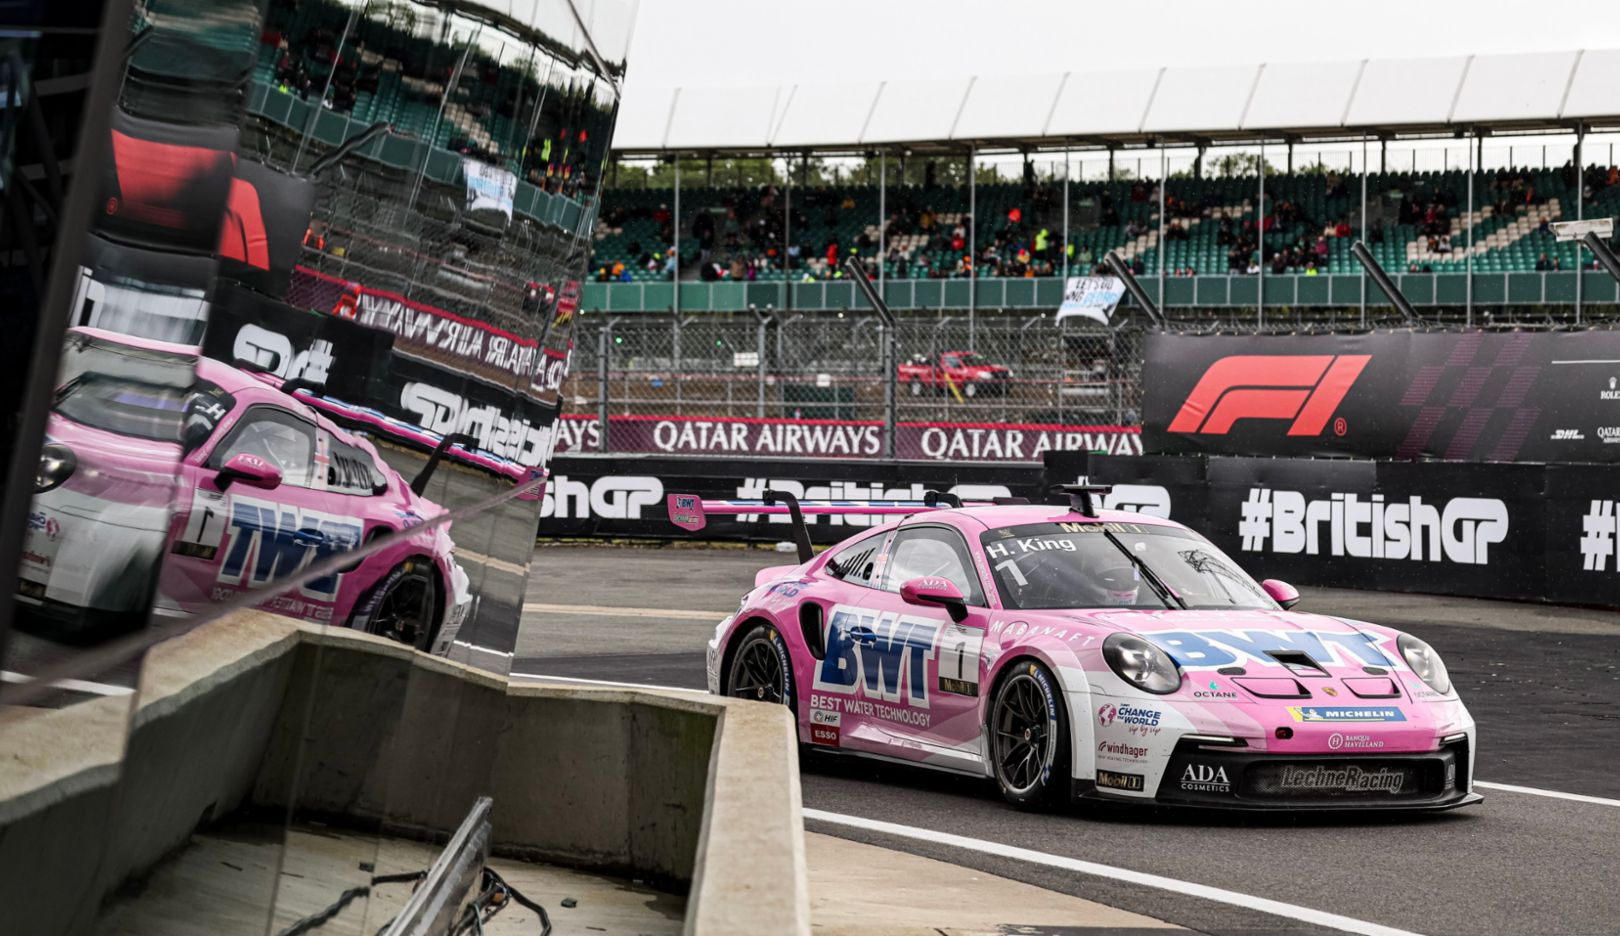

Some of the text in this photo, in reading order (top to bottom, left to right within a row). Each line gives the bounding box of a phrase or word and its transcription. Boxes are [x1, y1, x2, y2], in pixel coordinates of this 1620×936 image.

[653, 421, 881, 454] QATAR AIRWAYS
[921, 427, 1024, 459] QATAR
[1238, 487, 1509, 565] #BritishGP
[986, 538, 1077, 559] H. King
[990, 619, 1094, 646] MABANAFT
[812, 604, 946, 708] BWT
[954, 641, 966, 680] 1
[1144, 628, 1409, 671] BWT
[1036, 673, 1056, 717] MICHELIN
[811, 694, 931, 728] BEST WATER TECHNOLOGY
[1118, 707, 1161, 719] CHANGE
[1124, 717, 1159, 726] WORLD
[1325, 710, 1395, 718] MICHELIN
[814, 730, 836, 740] ESSO
[1107, 742, 1149, 759] windhager
[1181, 763, 1230, 783] ADA
[1180, 783, 1230, 792] COSMETICS
